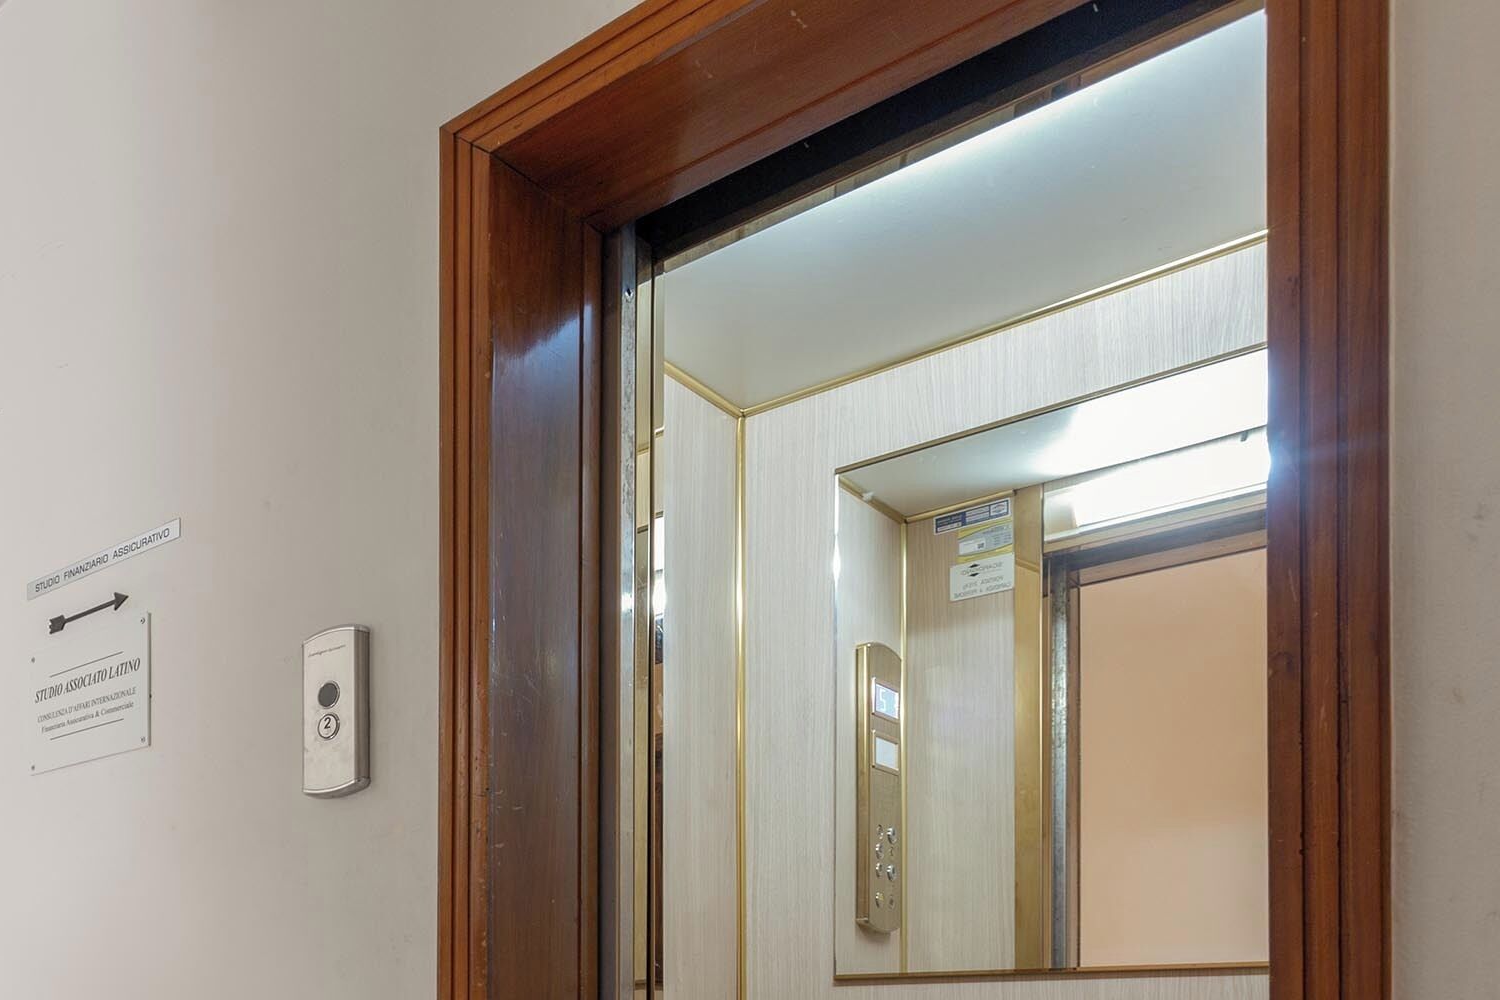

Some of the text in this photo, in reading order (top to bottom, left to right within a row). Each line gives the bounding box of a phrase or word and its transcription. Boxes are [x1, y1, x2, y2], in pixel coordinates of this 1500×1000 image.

[35, 528, 170, 592] STUDIO FINANZIARIO ASSICURATIVO
[34, 657, 141, 704] STUDIO ASSOCIATO LATINO
[37, 707, 68, 723] CONSULENZA
[92, 686, 136, 707] INTERNAZIONALE
[94, 710, 100, 718] &
[100, 701, 134, 716] Commerciale
[324, 716, 331, 730] 2
